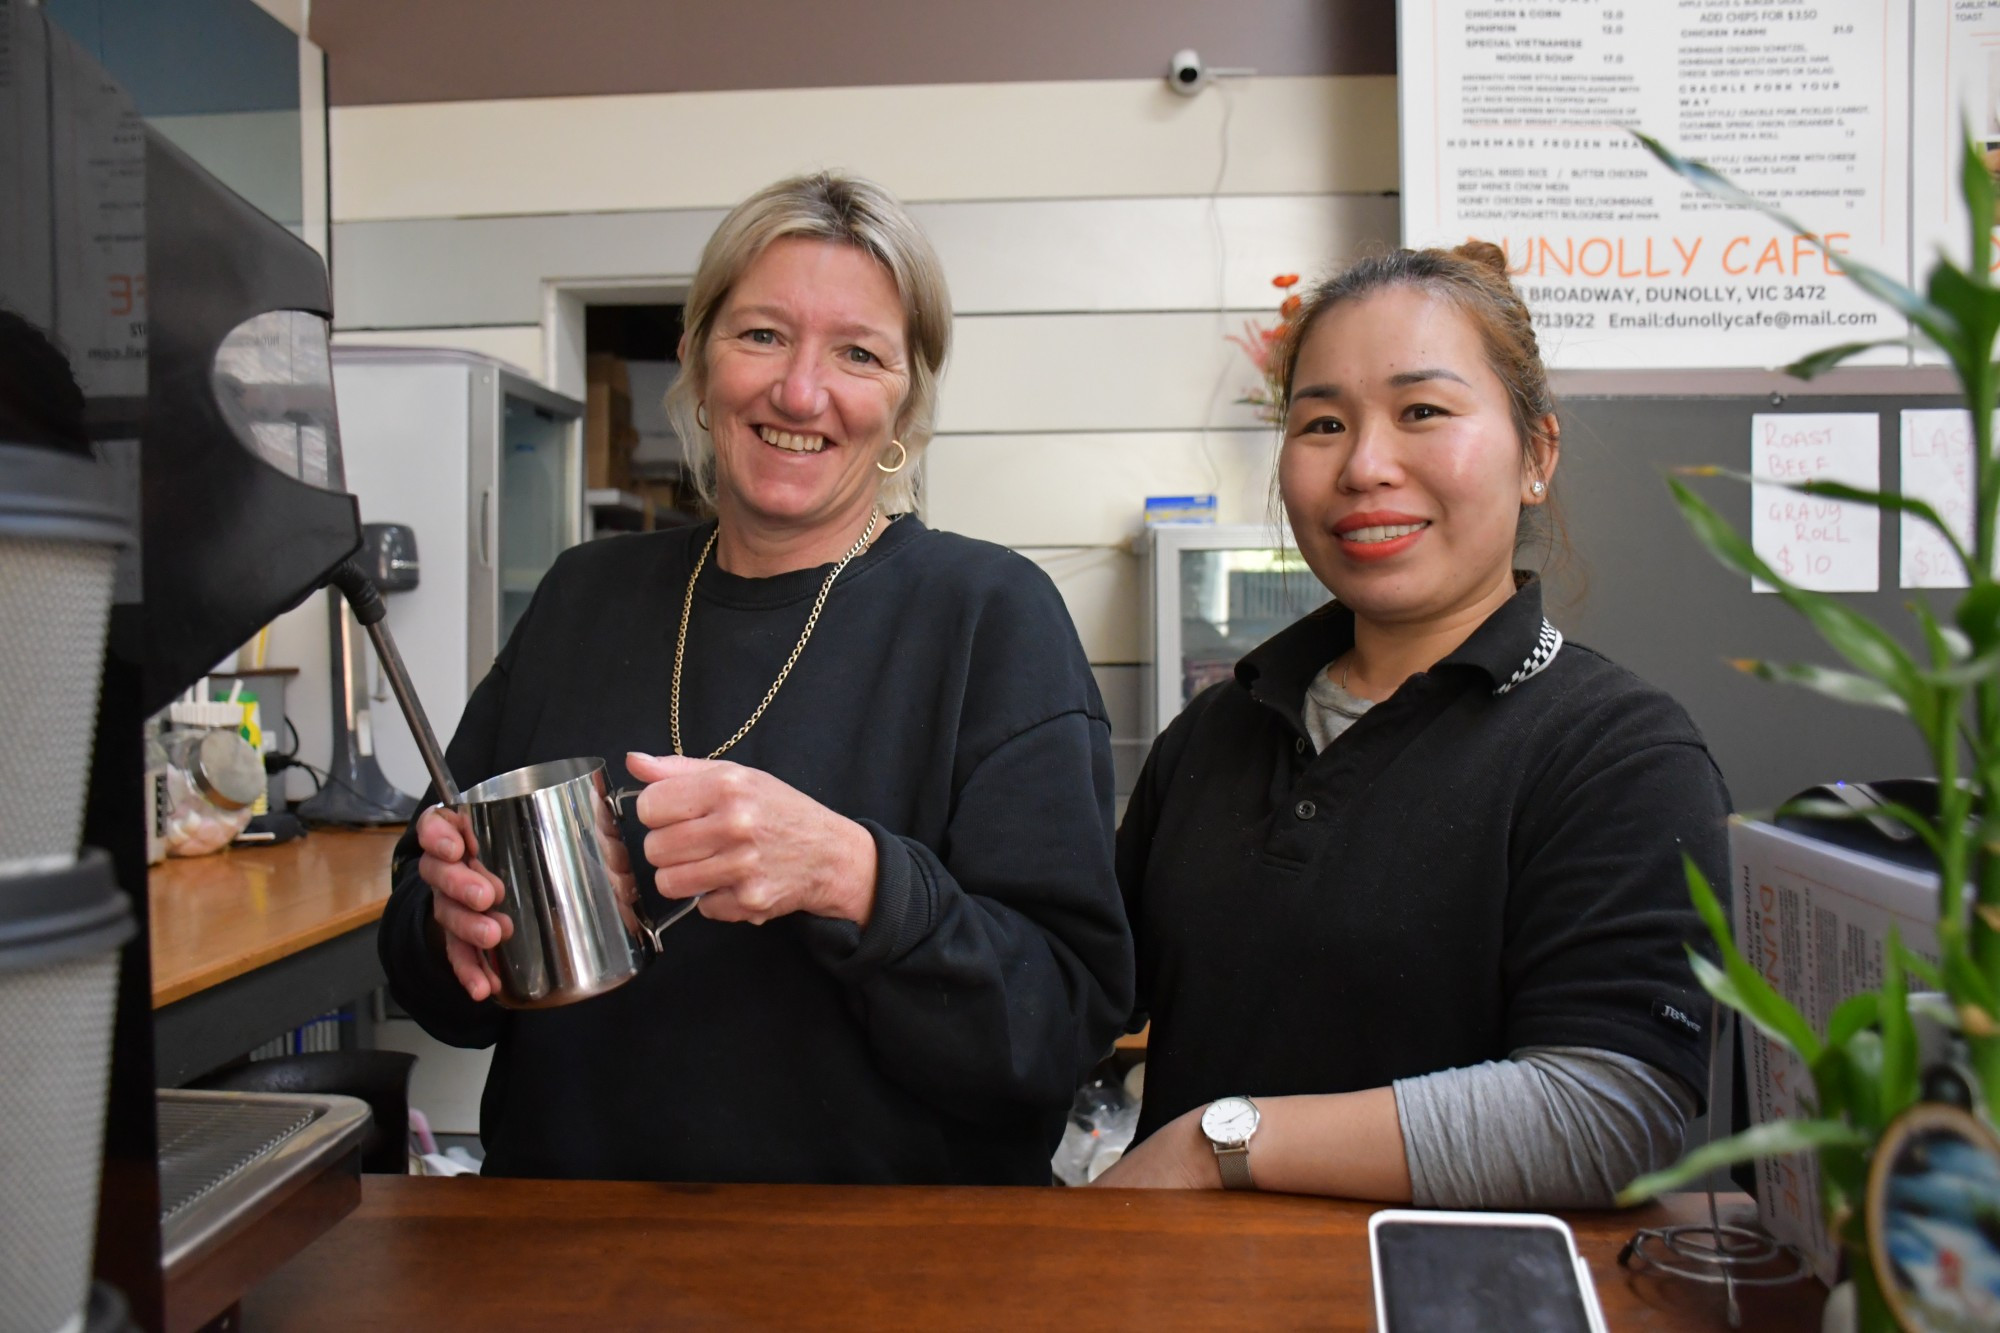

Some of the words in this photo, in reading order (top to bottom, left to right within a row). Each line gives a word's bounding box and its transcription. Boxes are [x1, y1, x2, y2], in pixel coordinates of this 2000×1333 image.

[1700, 11, 1723, 22] ADD
[1762, 10, 1784, 21] FOR
[1681, 28, 1728, 38] CHICKEN
[1466, 39, 1512, 48] SPECIAL
[1516, 39, 1582, 48] VIETNAMESE
[1679, 82, 1745, 94] CRACKLE
[1754, 82, 1792, 92] PORK
[1801, 80, 1840, 91] YOUR
[1680, 98, 1709, 107] WAY
[1447, 139, 1534, 149] HOMEMADE
[1543, 139, 1600, 149] FROZEN
[1609, 140, 1649, 150] MEA
[1467, 236, 1702, 278] UNOLLY
[1722, 232, 1850, 277] CAFE
[1530, 286, 1640, 304] BROADWAY,
[1646, 286, 1742, 304] DUNOLLY,
[1746, 286, 1779, 301] VIC
[1784, 285, 1826, 300] 3472
[1535, 312, 1594, 329] 713922
[1609, 310, 1878, 331] Email:dunollycafe@mail.com
[1764, 422, 1833, 447] ROAST
[1909, 418, 1974, 458] LAS
[1768, 454, 1829, 478] BEEF
[1795, 524, 1850, 543] ROLL
